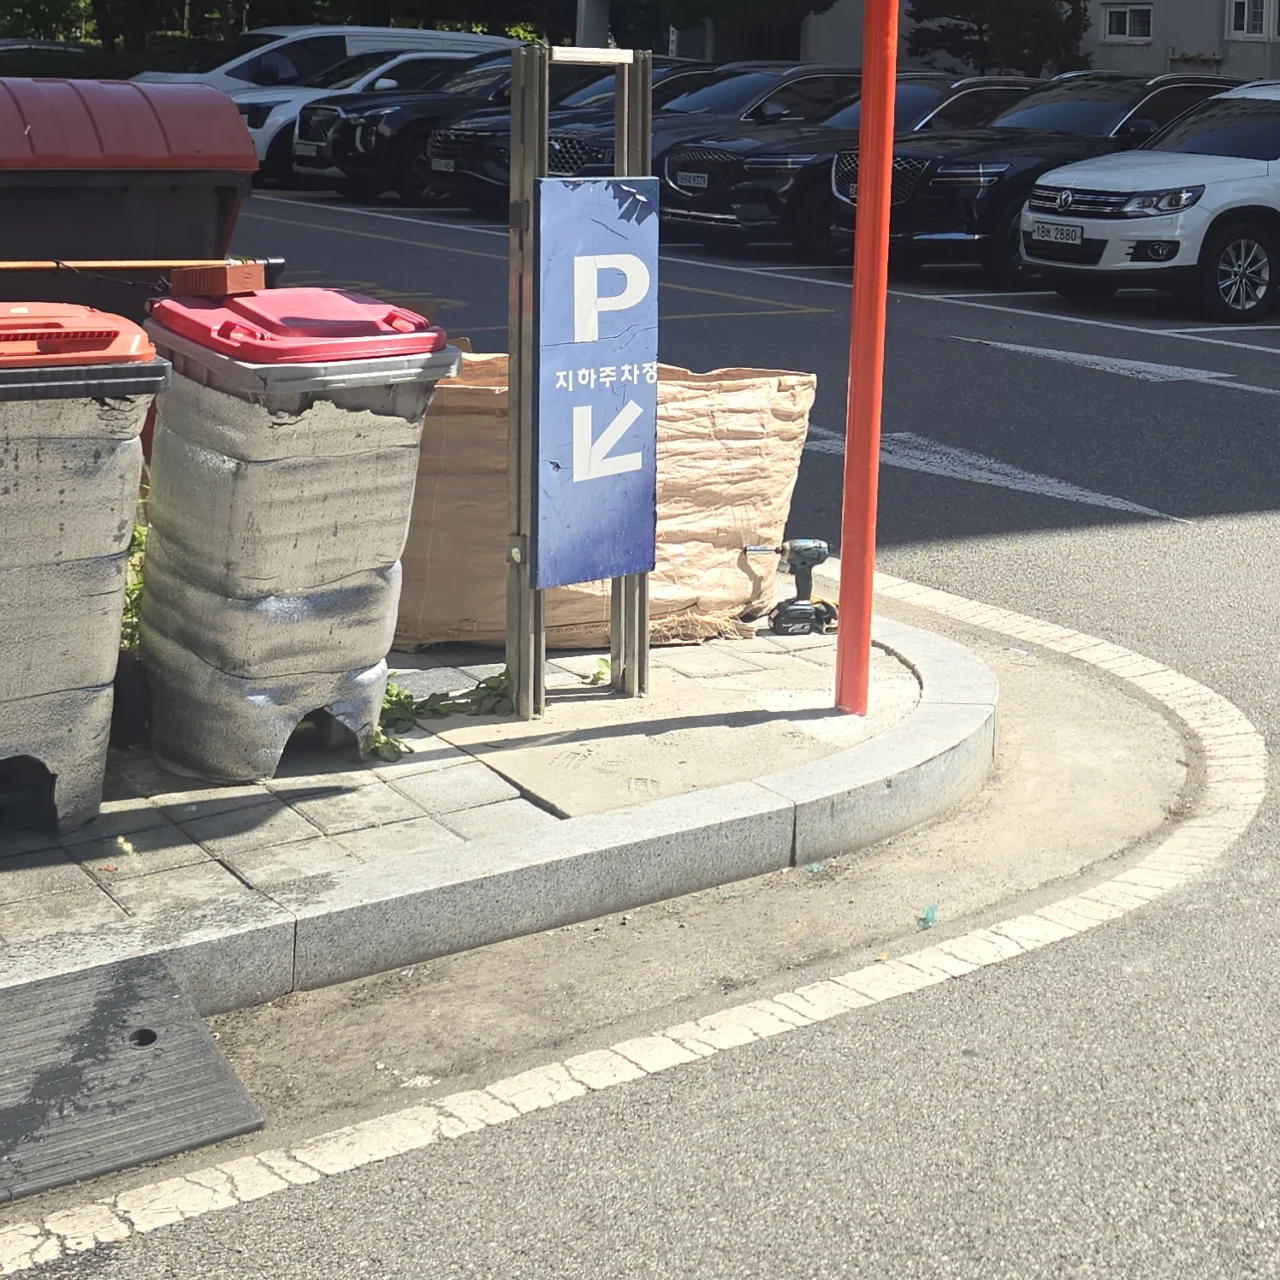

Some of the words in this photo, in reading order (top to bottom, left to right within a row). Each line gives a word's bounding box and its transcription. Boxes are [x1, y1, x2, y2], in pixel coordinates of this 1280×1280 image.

[1054, 227, 1077, 241] 2880
[573, 253, 650, 342] P
[555, 361, 657, 392] 지하주차장
